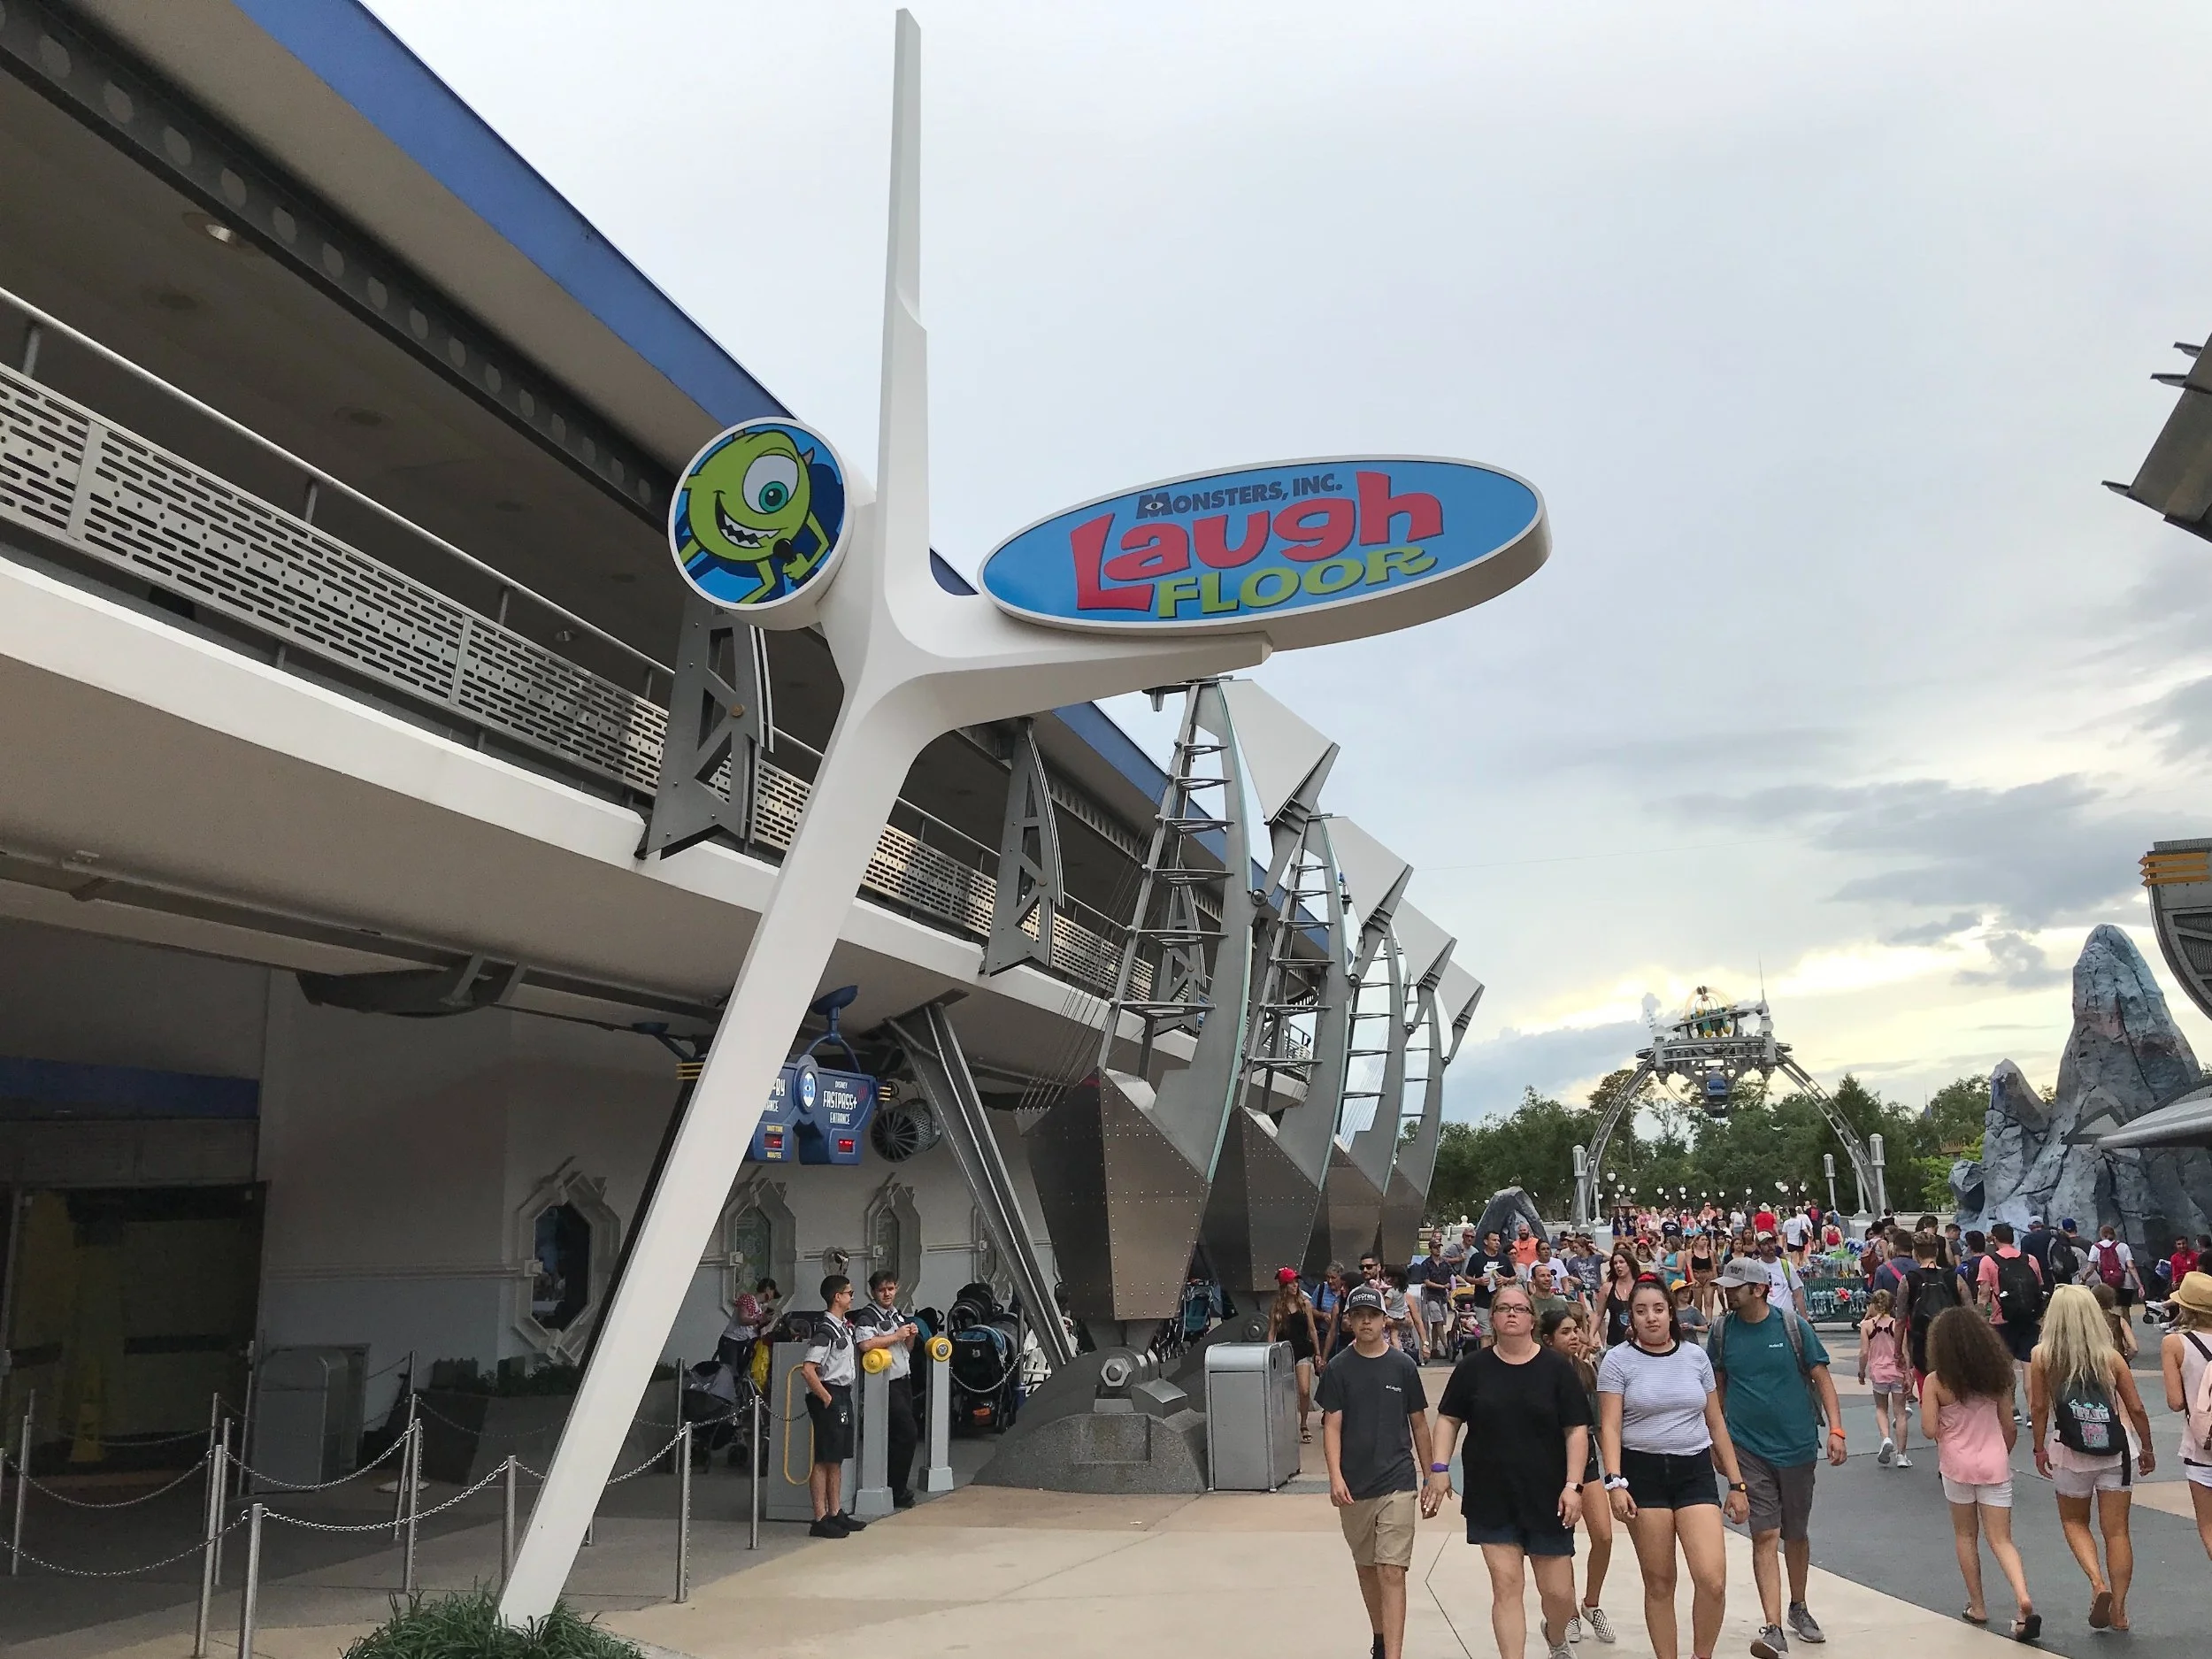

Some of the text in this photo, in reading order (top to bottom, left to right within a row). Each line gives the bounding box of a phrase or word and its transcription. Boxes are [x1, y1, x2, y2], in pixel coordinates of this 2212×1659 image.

[1136, 472, 1343, 519] MONSTERS, INC.
[1070, 471, 1444, 612] Laugh
[1156, 544, 1438, 618] FLOOR
[823, 1090, 857, 1110] FASTPASS+
[834, 1080, 849, 1089] DISNEY
[830, 1112, 850, 1125] ENTRANCE
